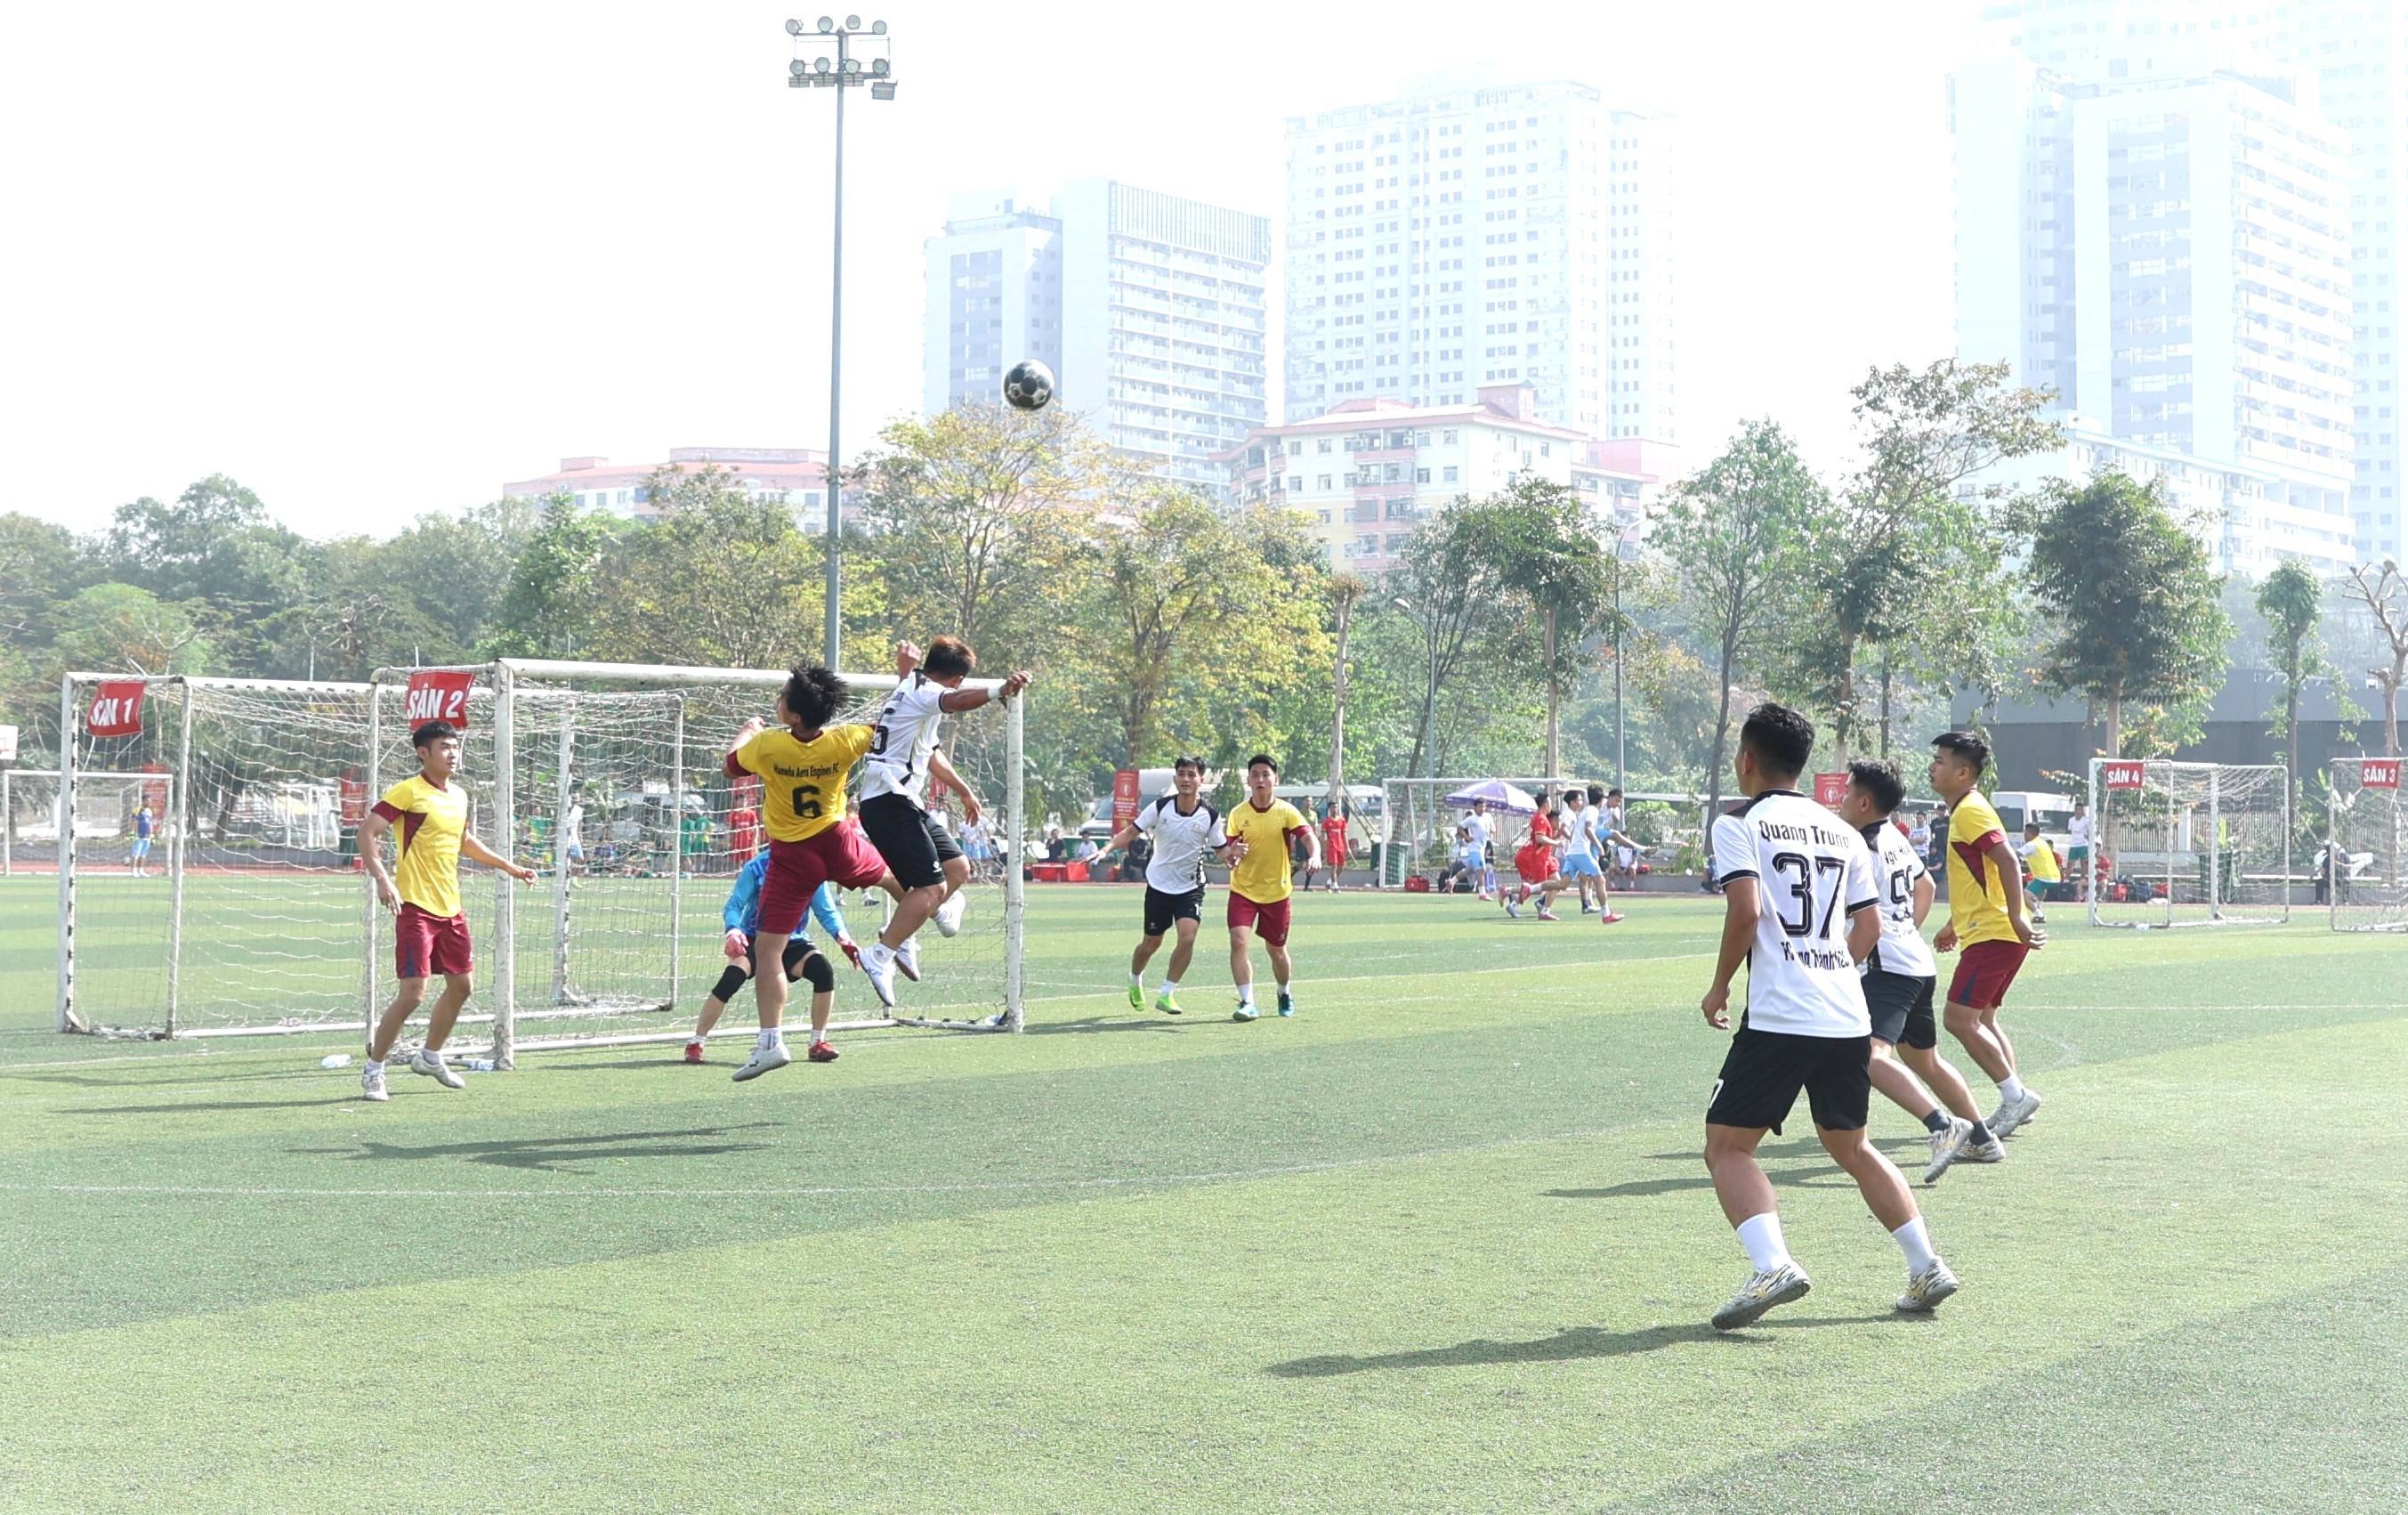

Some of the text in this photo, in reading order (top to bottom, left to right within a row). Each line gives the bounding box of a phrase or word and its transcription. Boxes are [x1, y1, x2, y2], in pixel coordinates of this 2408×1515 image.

[124, 698, 133, 724] 1
[407, 683, 464, 719] SÂN 2
[2107, 767, 2139, 784] SÂN 4
[2363, 765, 2396, 783] SÂN 3
[792, 785, 823, 819] 6
[1758, 820, 1807, 846] Quang
[1772, 852, 1846, 940] 37
